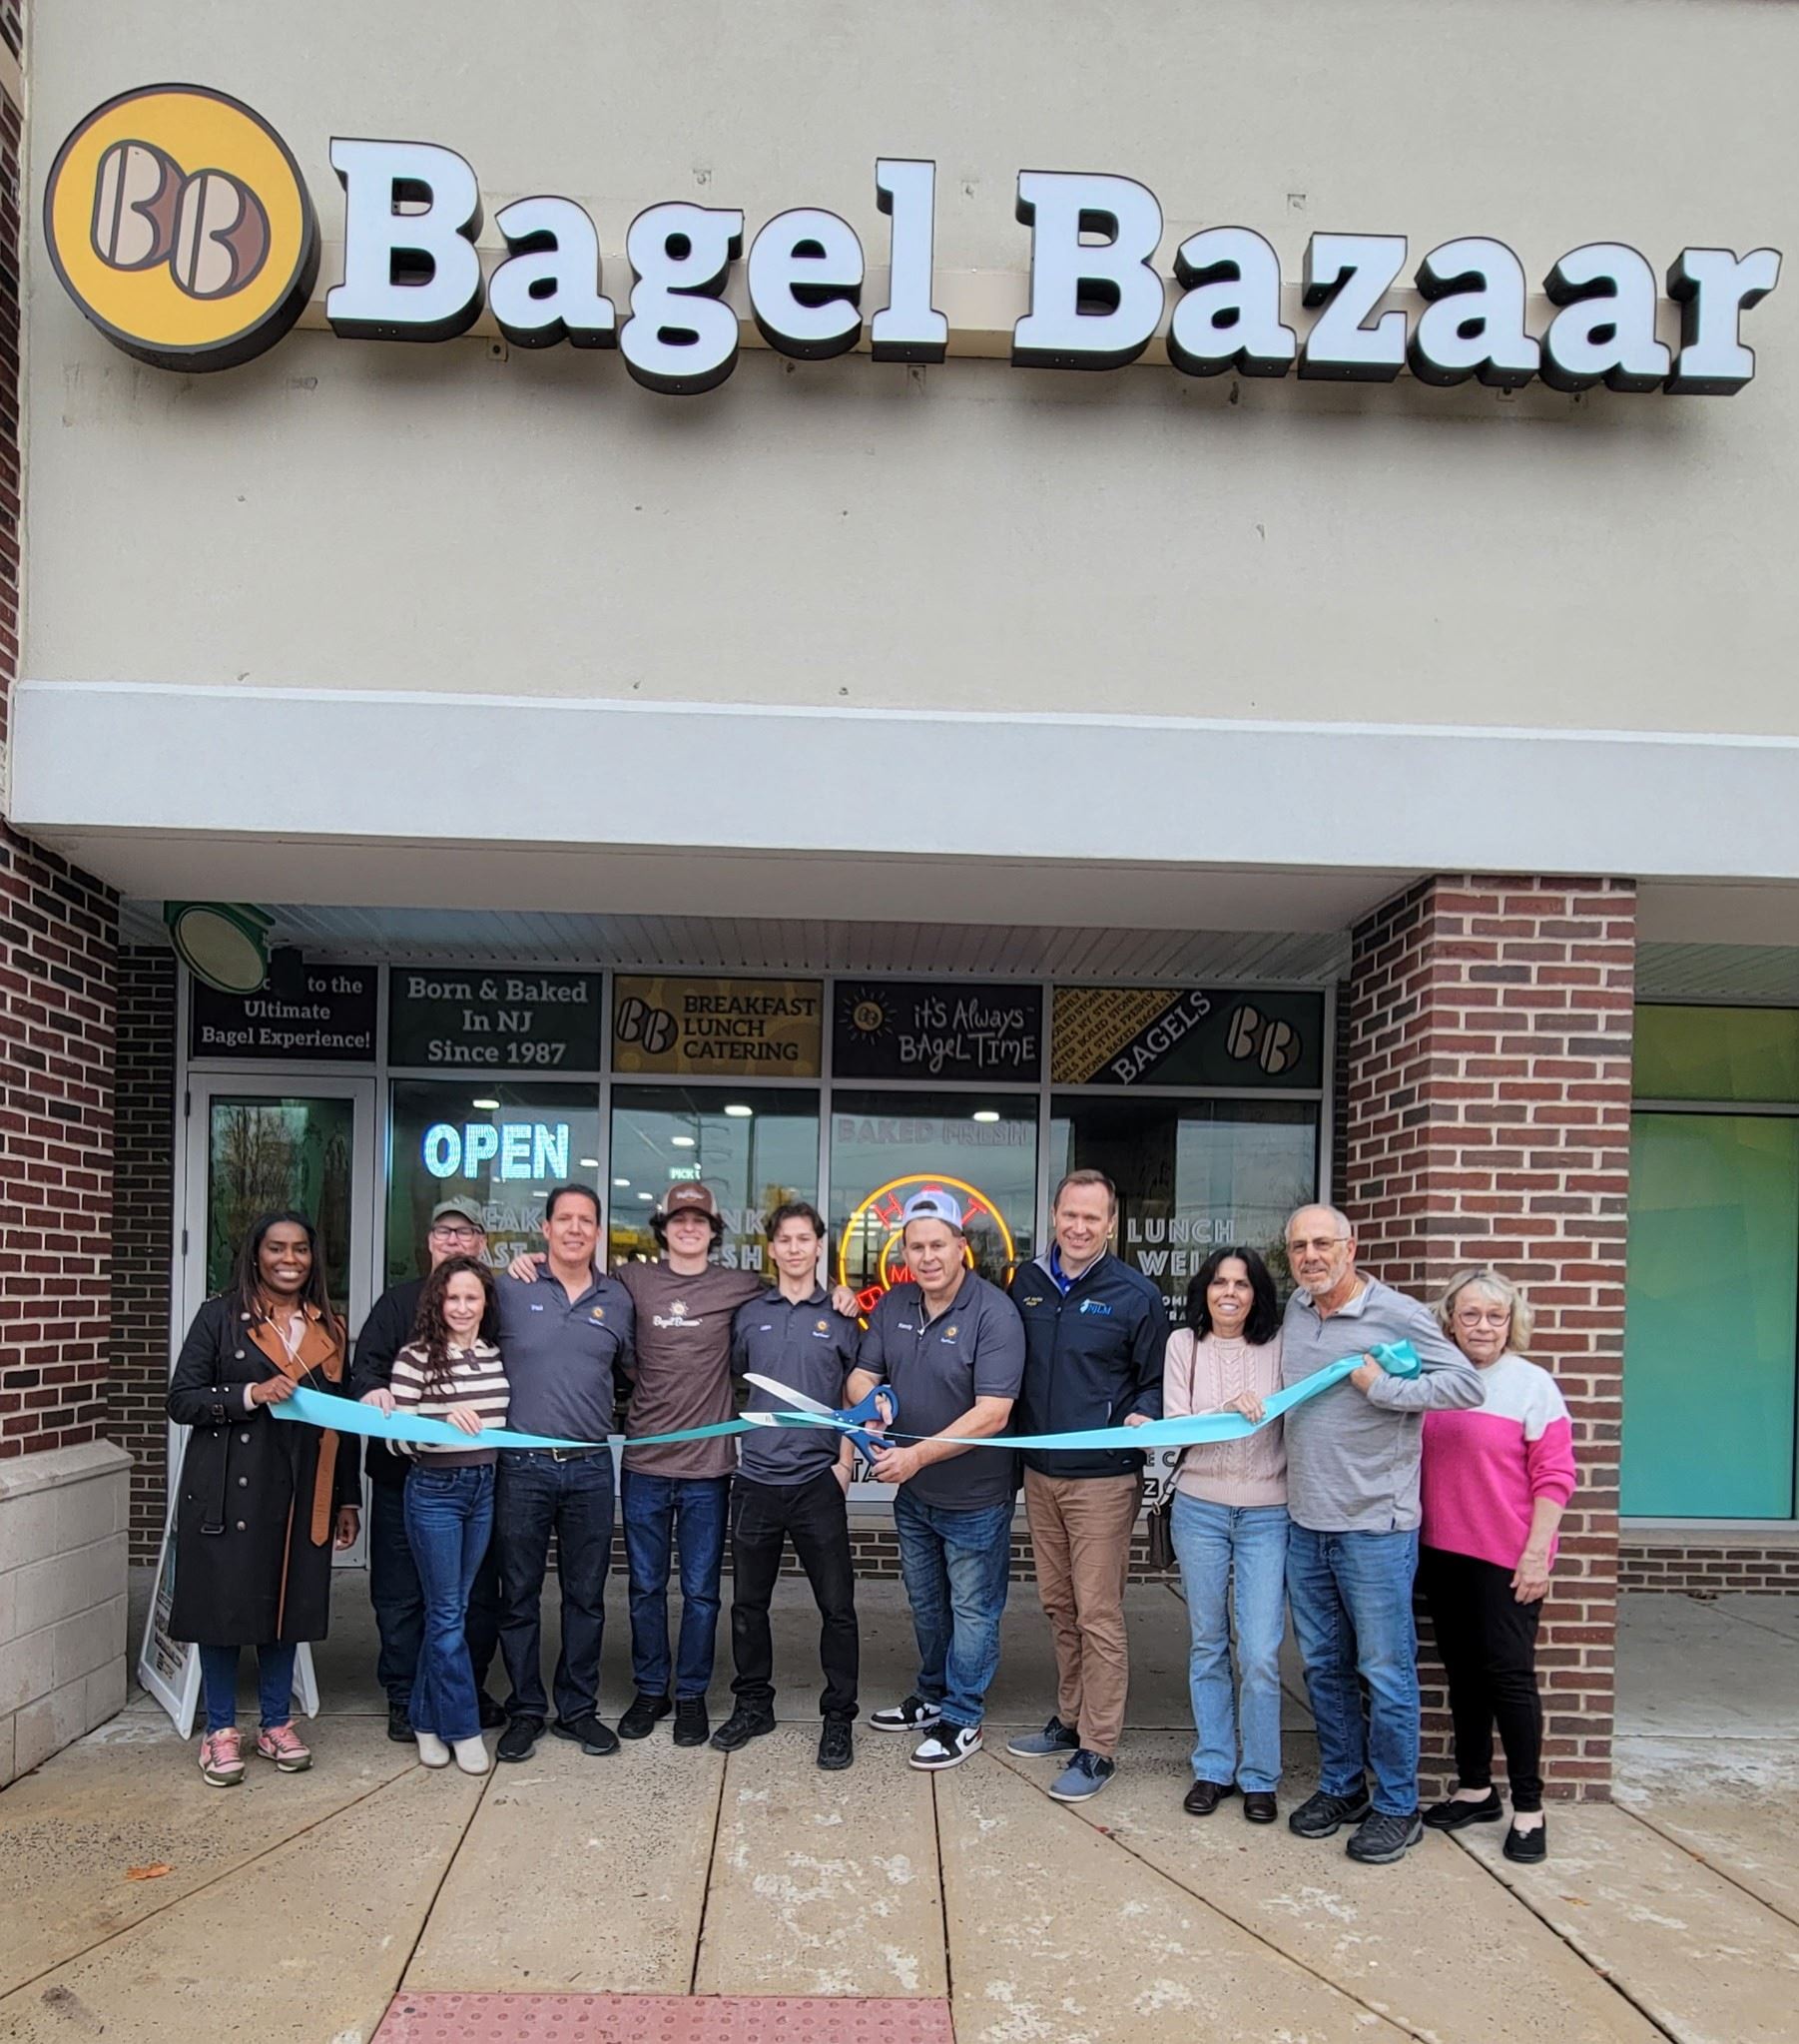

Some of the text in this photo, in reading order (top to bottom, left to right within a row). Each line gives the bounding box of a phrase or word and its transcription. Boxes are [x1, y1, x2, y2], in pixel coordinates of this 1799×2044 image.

[90, 139, 272, 301] BB
[327, 136, 1783, 389] Bagel Bazaar
[307, 975, 363, 994] to the
[407, 976, 589, 1004] Born & Baked
[244, 1000, 330, 1020] Ultimate
[683, 995, 817, 1017] BREAKFAST
[951, 997, 1025, 1038] Always
[461, 1009, 533, 1032] In NJ
[683, 1018, 766, 1038] LUNCH
[202, 1025, 370, 1048] Bagel Experience!
[1110, 990, 1211, 1086] BAGELS
[427, 1039, 567, 1065] Since 1987
[683, 1039, 800, 1061] CATERING
[838, 1117, 1029, 1148] BAKED FRESH
[423, 1122, 569, 1179] OPEN
[1127, 1217, 1236, 1244] LUNCH
